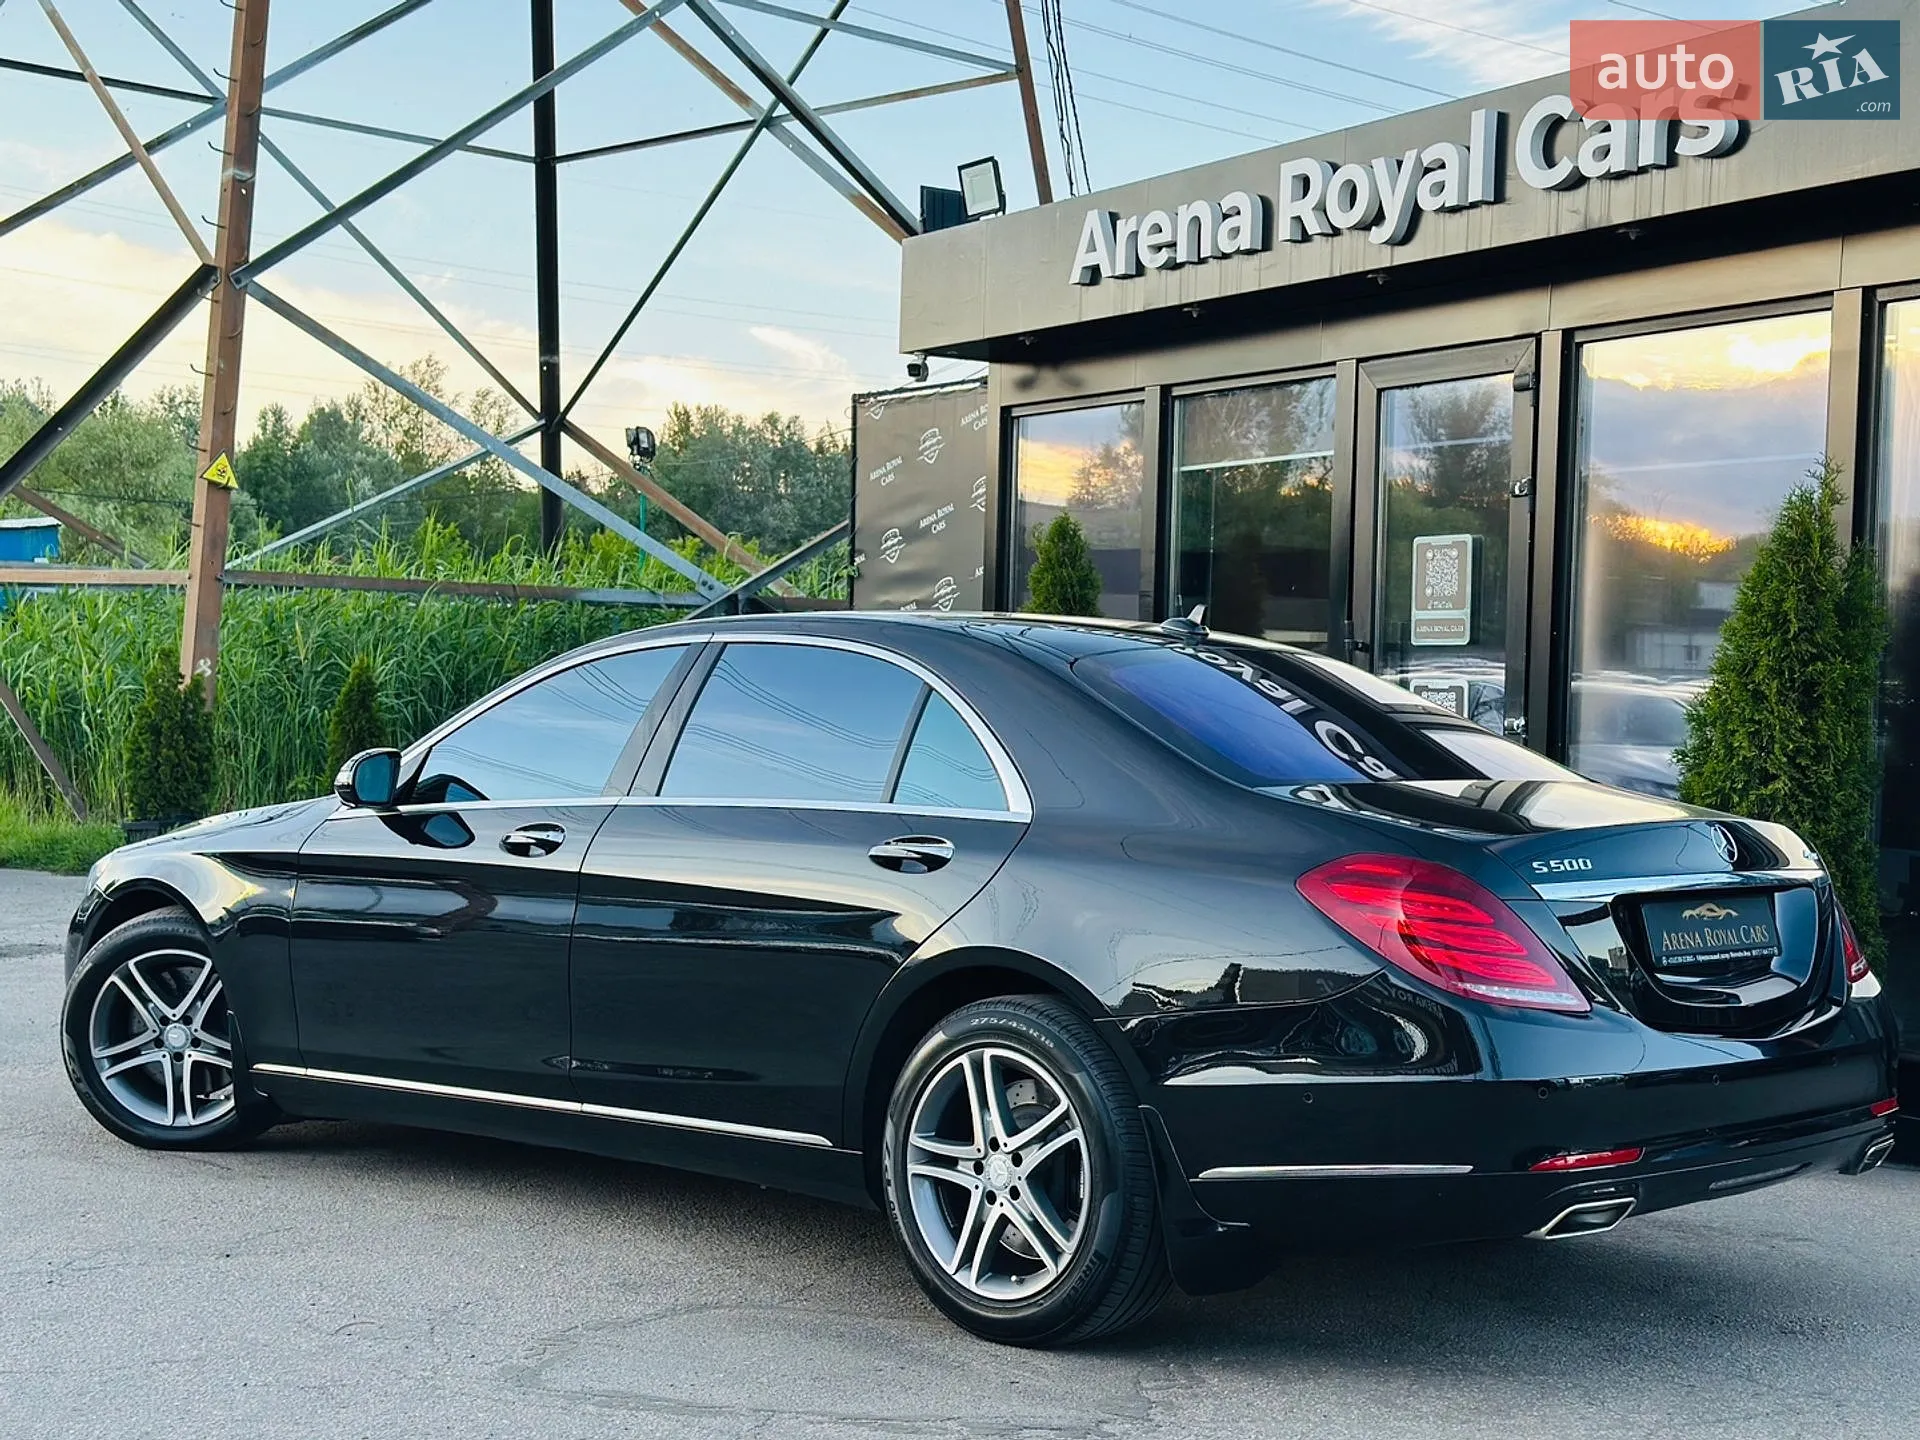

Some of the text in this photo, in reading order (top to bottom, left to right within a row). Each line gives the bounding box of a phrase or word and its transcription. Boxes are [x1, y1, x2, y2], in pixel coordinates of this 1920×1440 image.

[1069, 77, 1741, 285] Arena Royal Cars
[1661, 924, 1770, 951] ARENA ROYAL CARS
